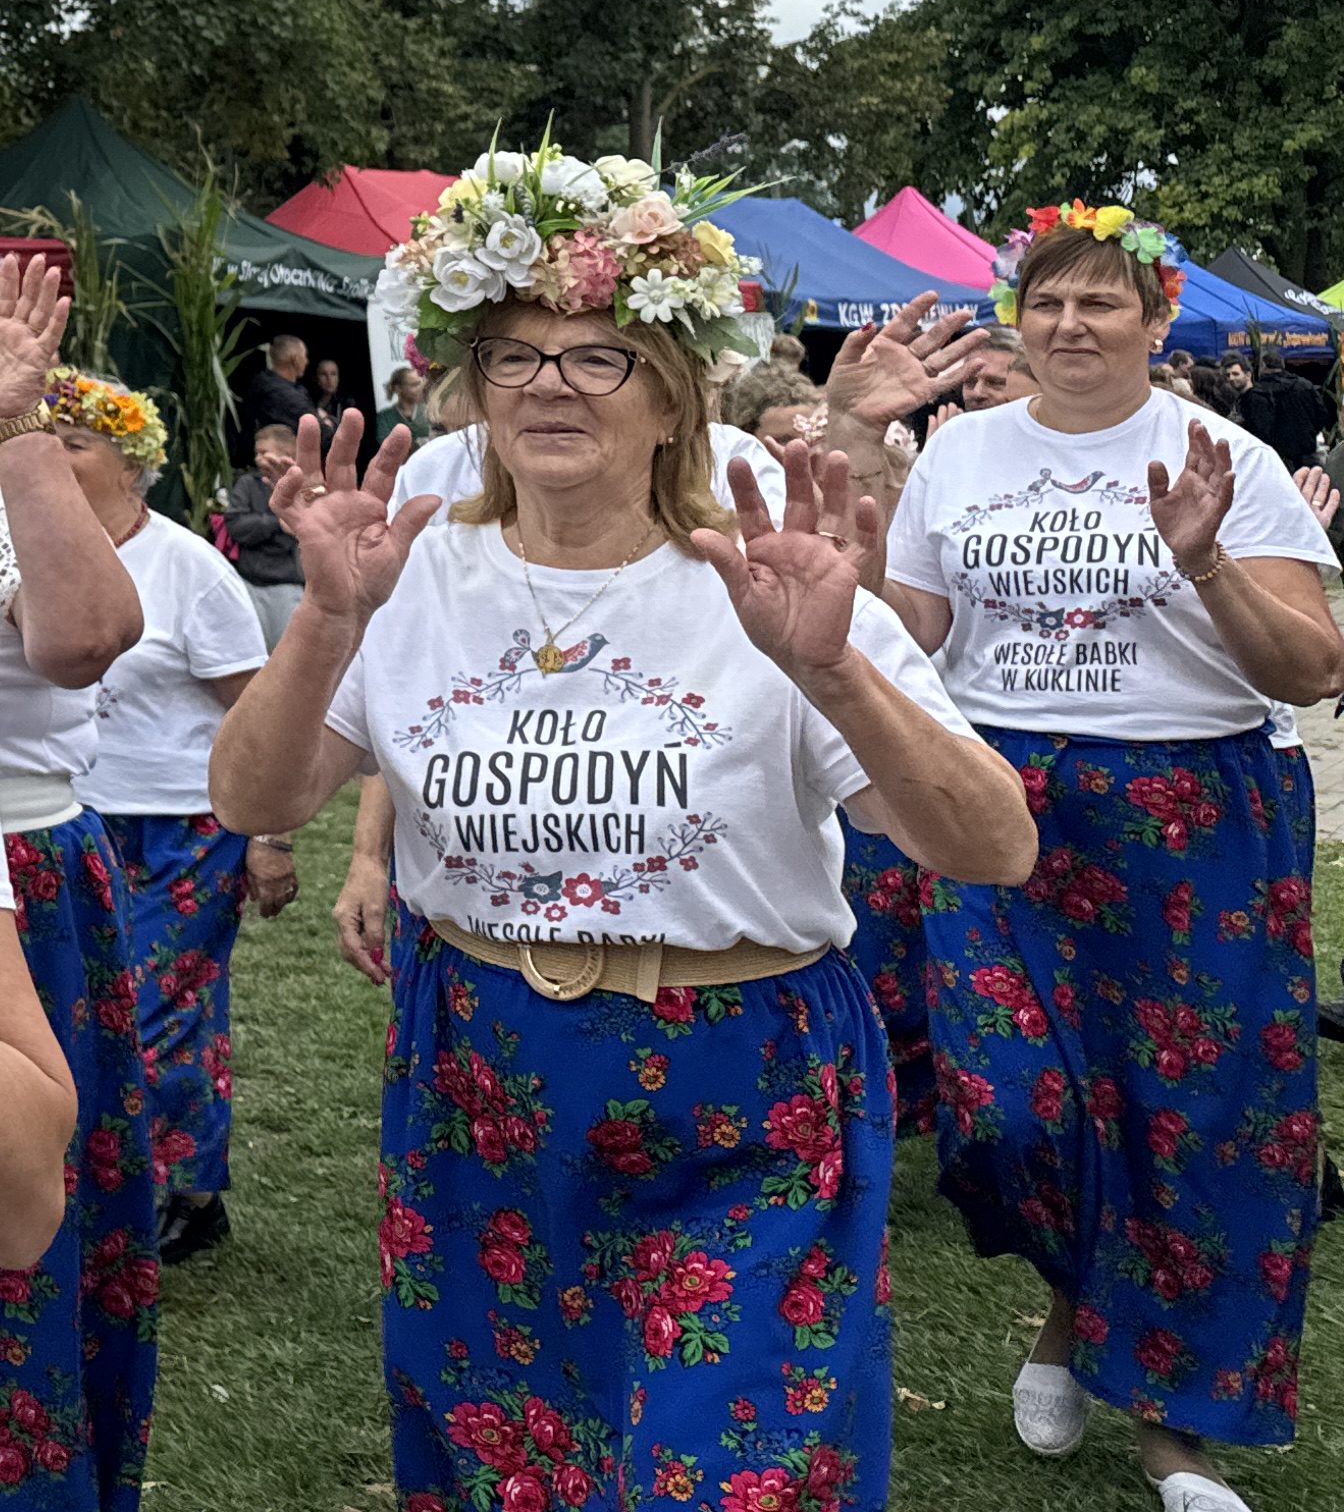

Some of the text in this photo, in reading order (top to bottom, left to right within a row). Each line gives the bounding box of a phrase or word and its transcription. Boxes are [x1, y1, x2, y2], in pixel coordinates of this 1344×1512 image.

[838, 302, 874, 327] KGW
[1029, 508, 1102, 533] KOŁO
[962, 527, 1160, 570] GOSPODYŃ
[988, 567, 1130, 597] WIEJSKICH
[994, 641, 1138, 666] WESOŁE BABKI
[1001, 668, 1122, 692] W KUKLINIE
[506, 709, 607, 746] KOŁO
[422, 741, 689, 810] GOSPODYŃ
[454, 812, 646, 855] WIEJSKICH
